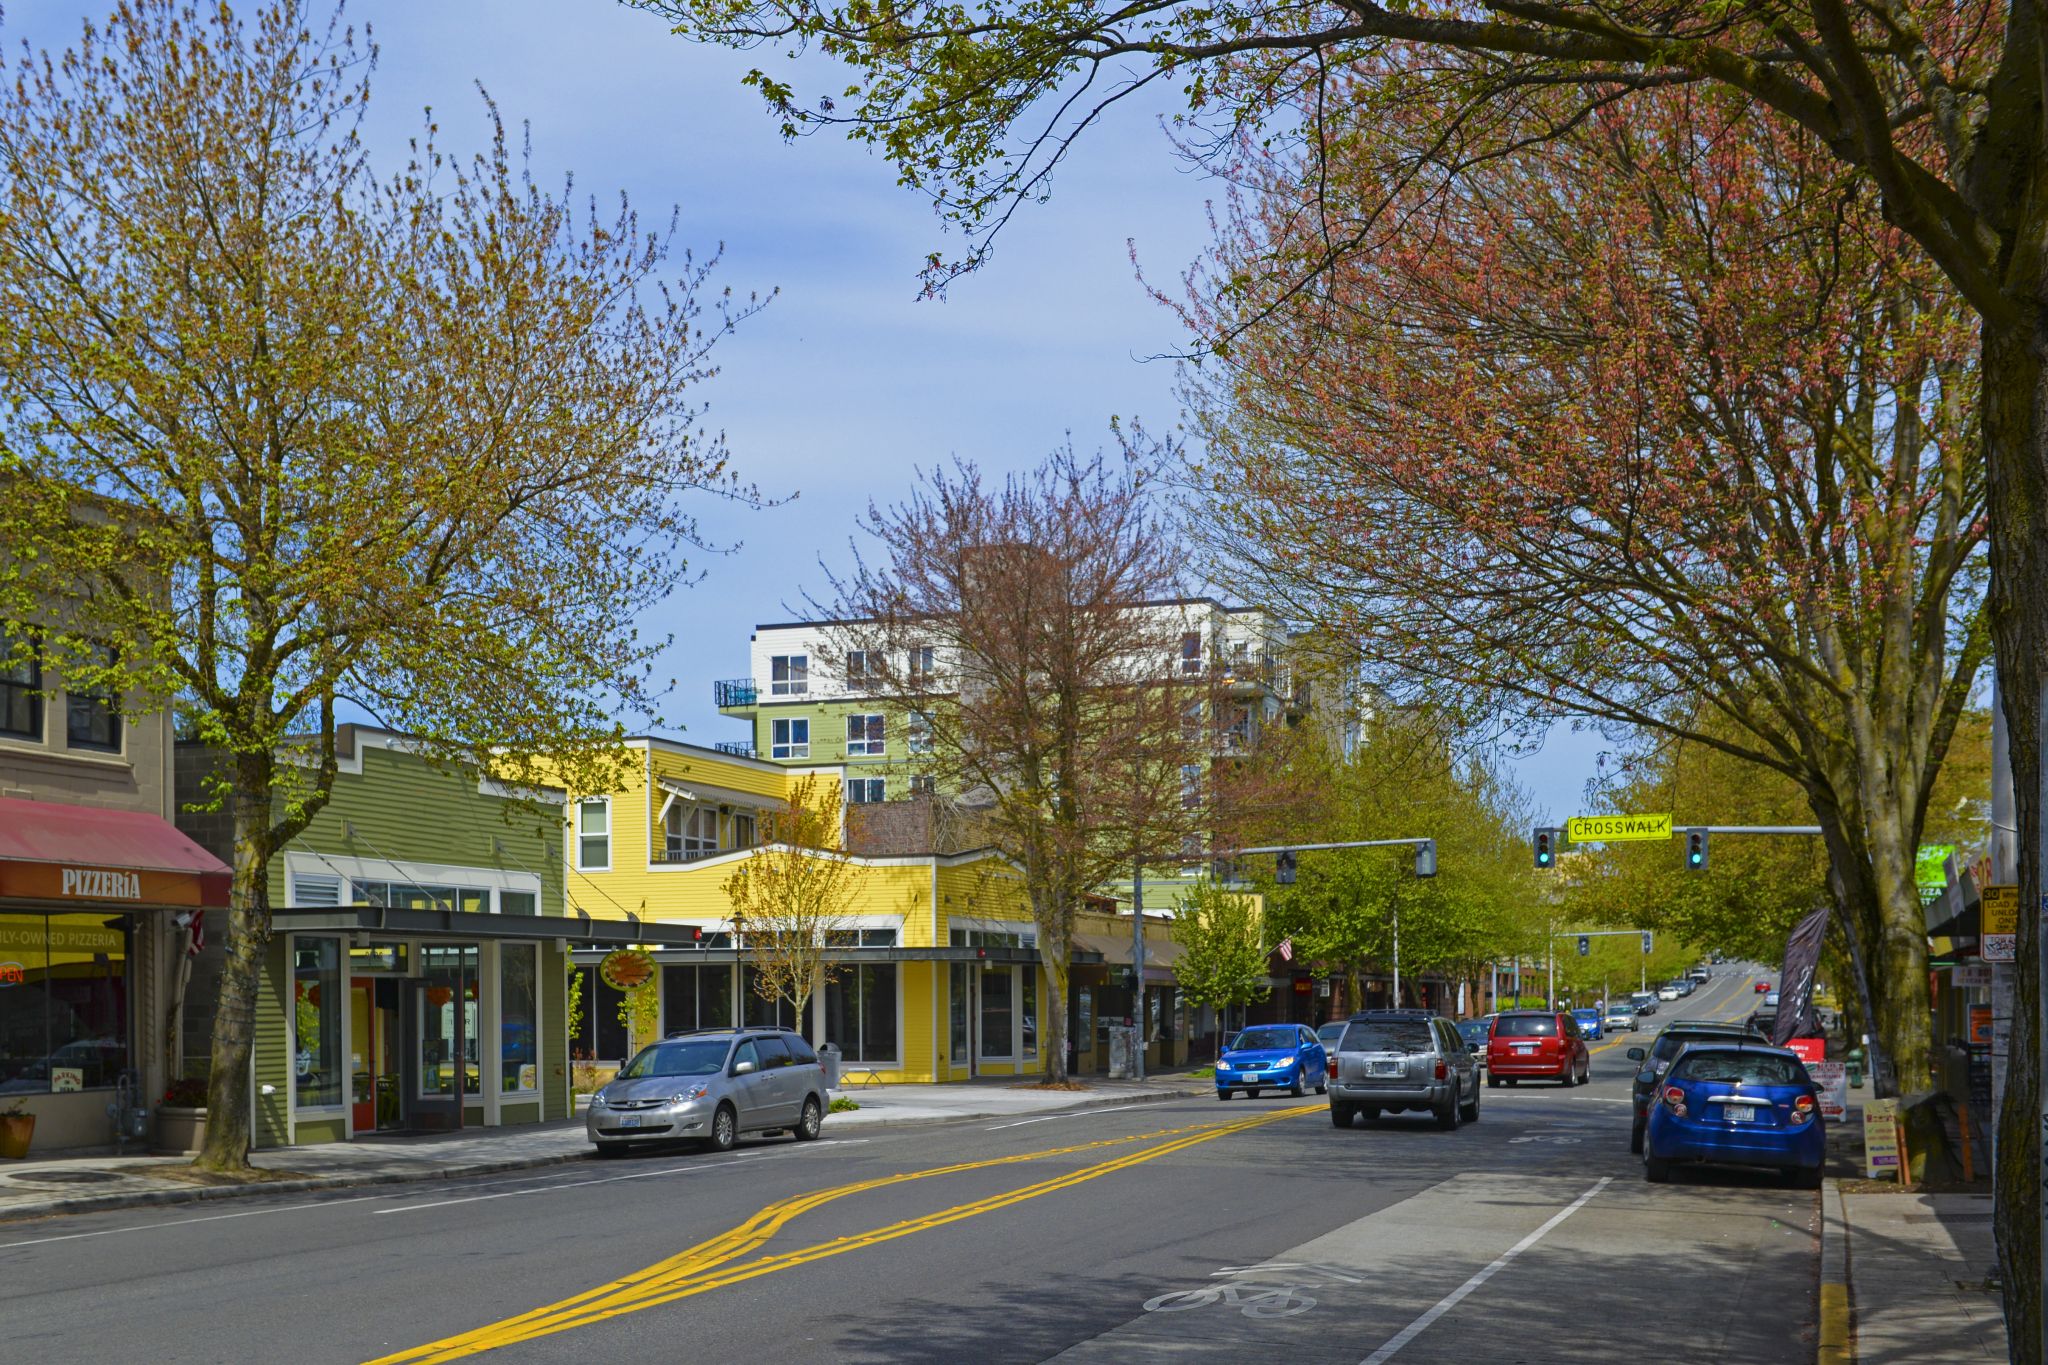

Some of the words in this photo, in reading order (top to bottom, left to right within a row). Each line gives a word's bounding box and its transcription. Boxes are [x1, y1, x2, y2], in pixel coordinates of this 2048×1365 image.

[1574, 820, 1666, 836] CROSSWALK
[1984, 887, 1999, 899] 30
[1987, 900, 2010, 909] LOAD
[69, 933, 117, 947] PIZZERIA
